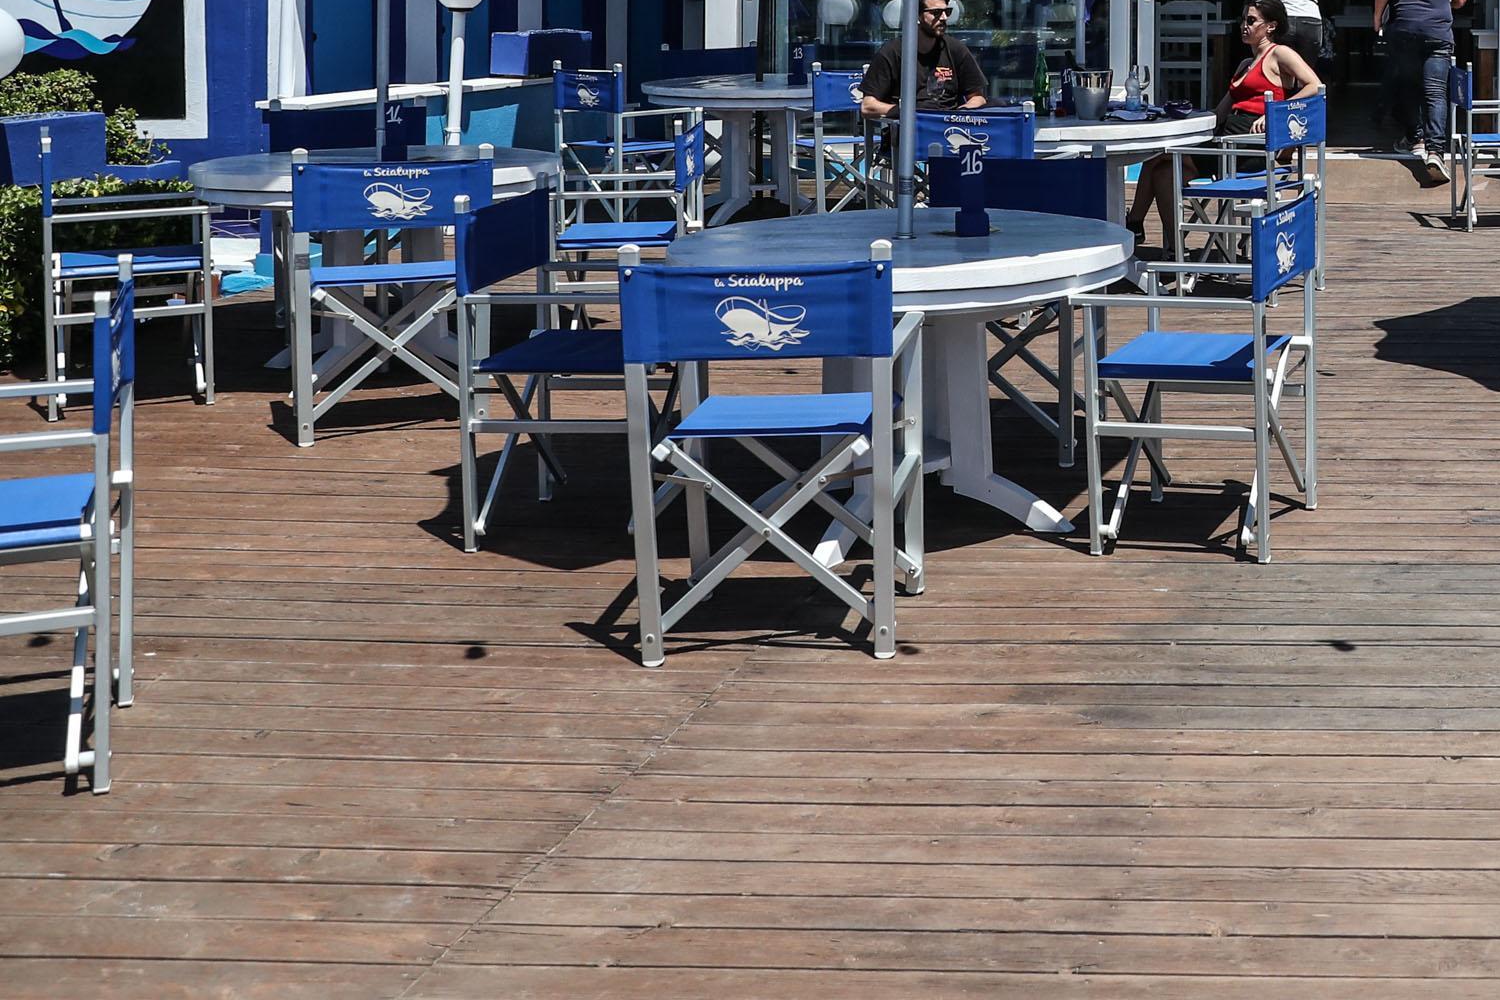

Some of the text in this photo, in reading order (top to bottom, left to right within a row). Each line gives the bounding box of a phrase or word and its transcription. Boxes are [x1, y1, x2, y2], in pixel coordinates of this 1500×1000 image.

[792, 47, 804, 60] 13
[960, 149, 983, 176] 16
[373, 166, 430, 180] Scialuppa
[714, 273, 805, 292] la Scialuppa
